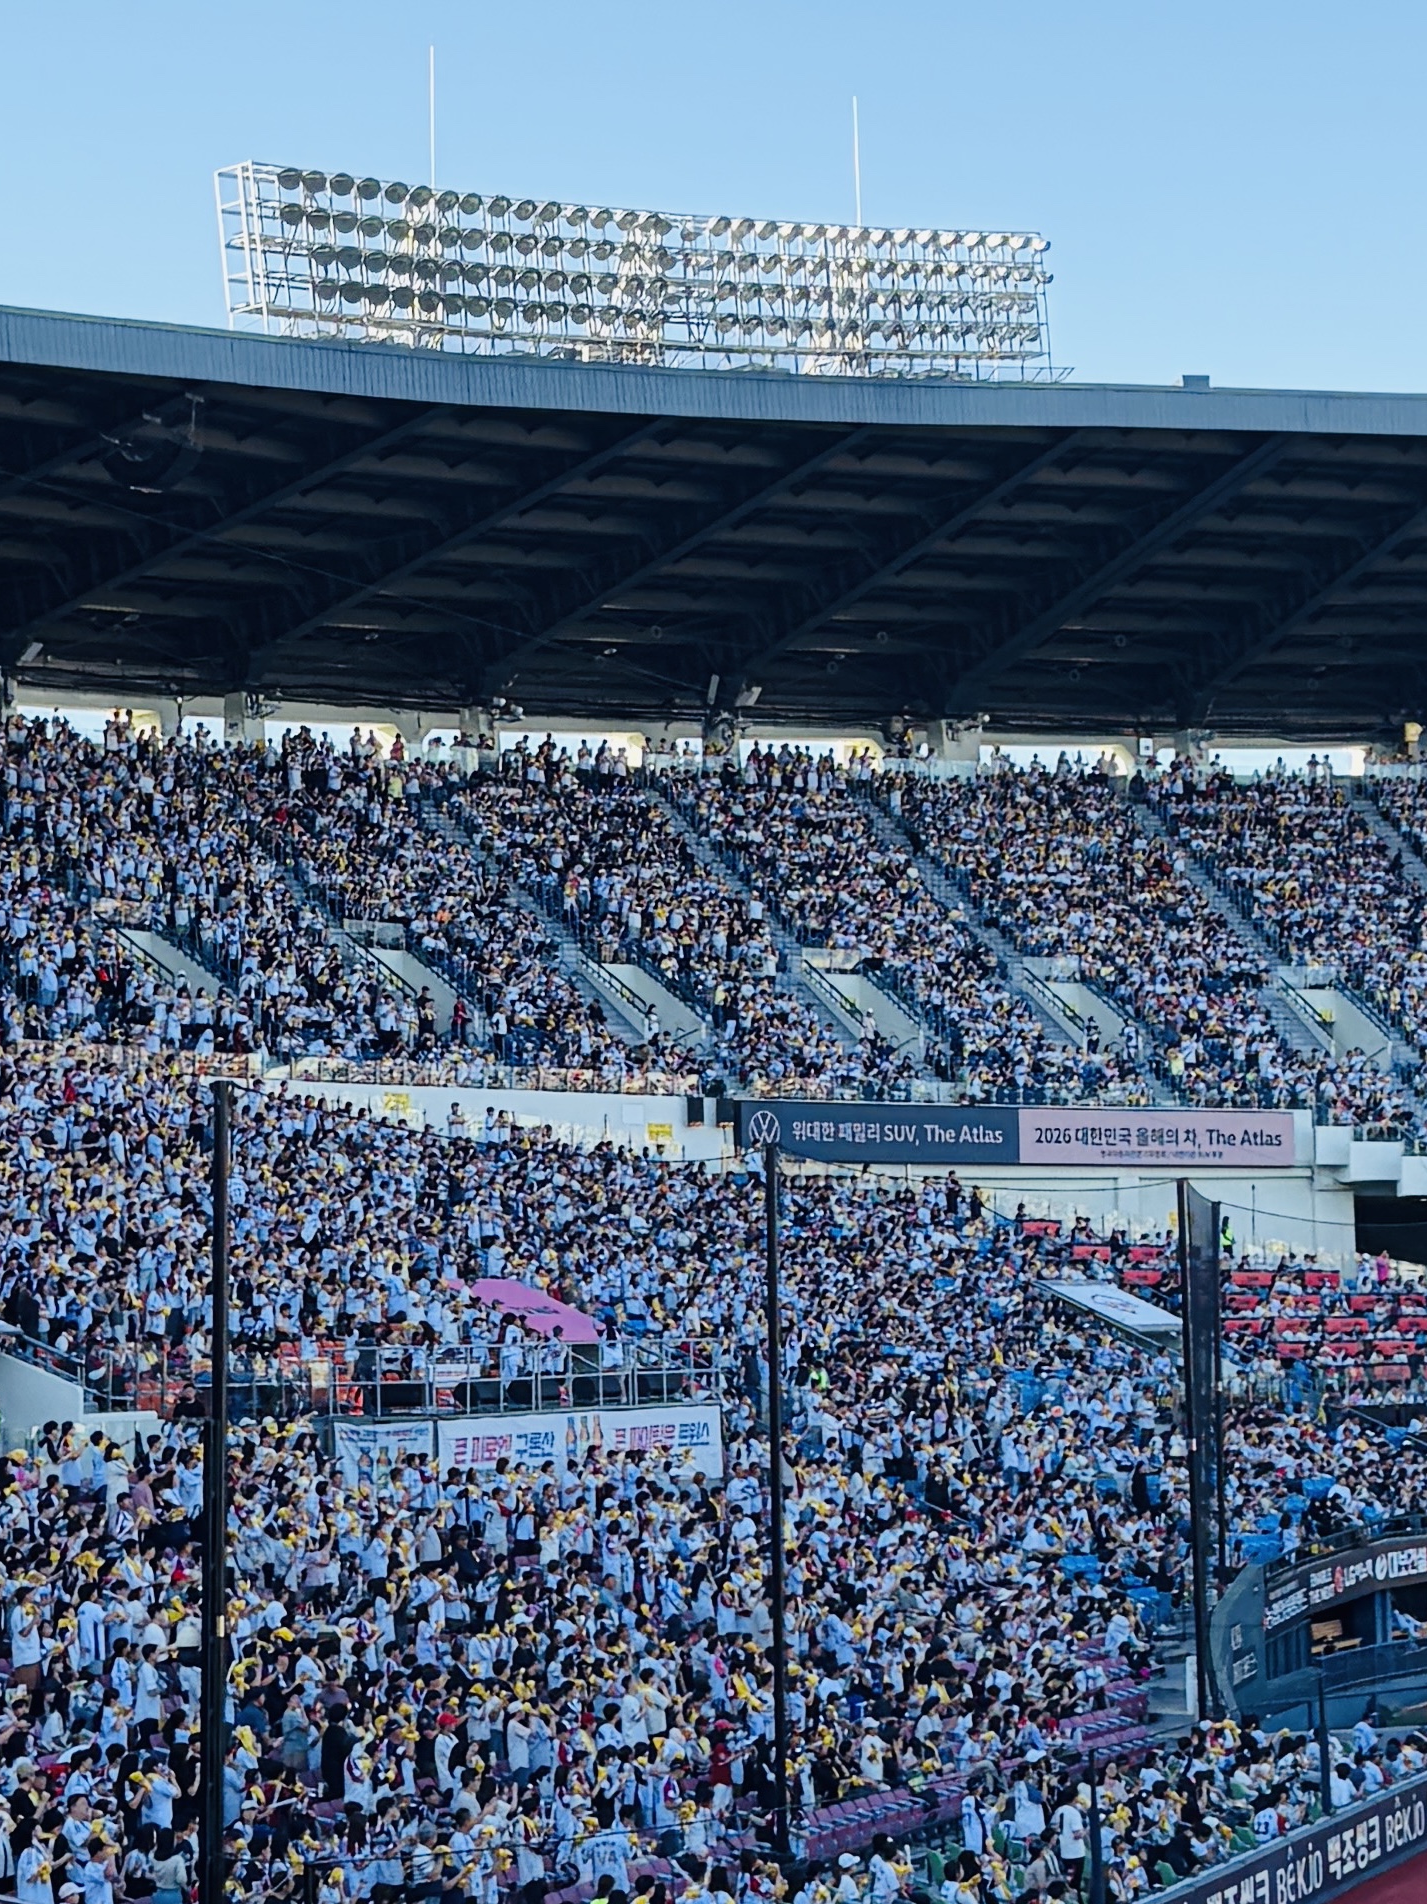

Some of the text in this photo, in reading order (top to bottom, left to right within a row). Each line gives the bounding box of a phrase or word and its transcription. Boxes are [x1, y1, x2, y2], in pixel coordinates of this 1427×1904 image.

[792, 1121, 1003, 1145] 위대한 패밀리 SUV, The Atlas
[1034, 1127, 1071, 1144] 2026
[1075, 1127, 1132, 1146] 대한민국
[1136, 1127, 1179, 1146] 올해의
[1206, 1129, 1236, 1146] The
[1240, 1129, 1282, 1146] Atlas
[1328, 1814, 1381, 1881] 백조씽크
